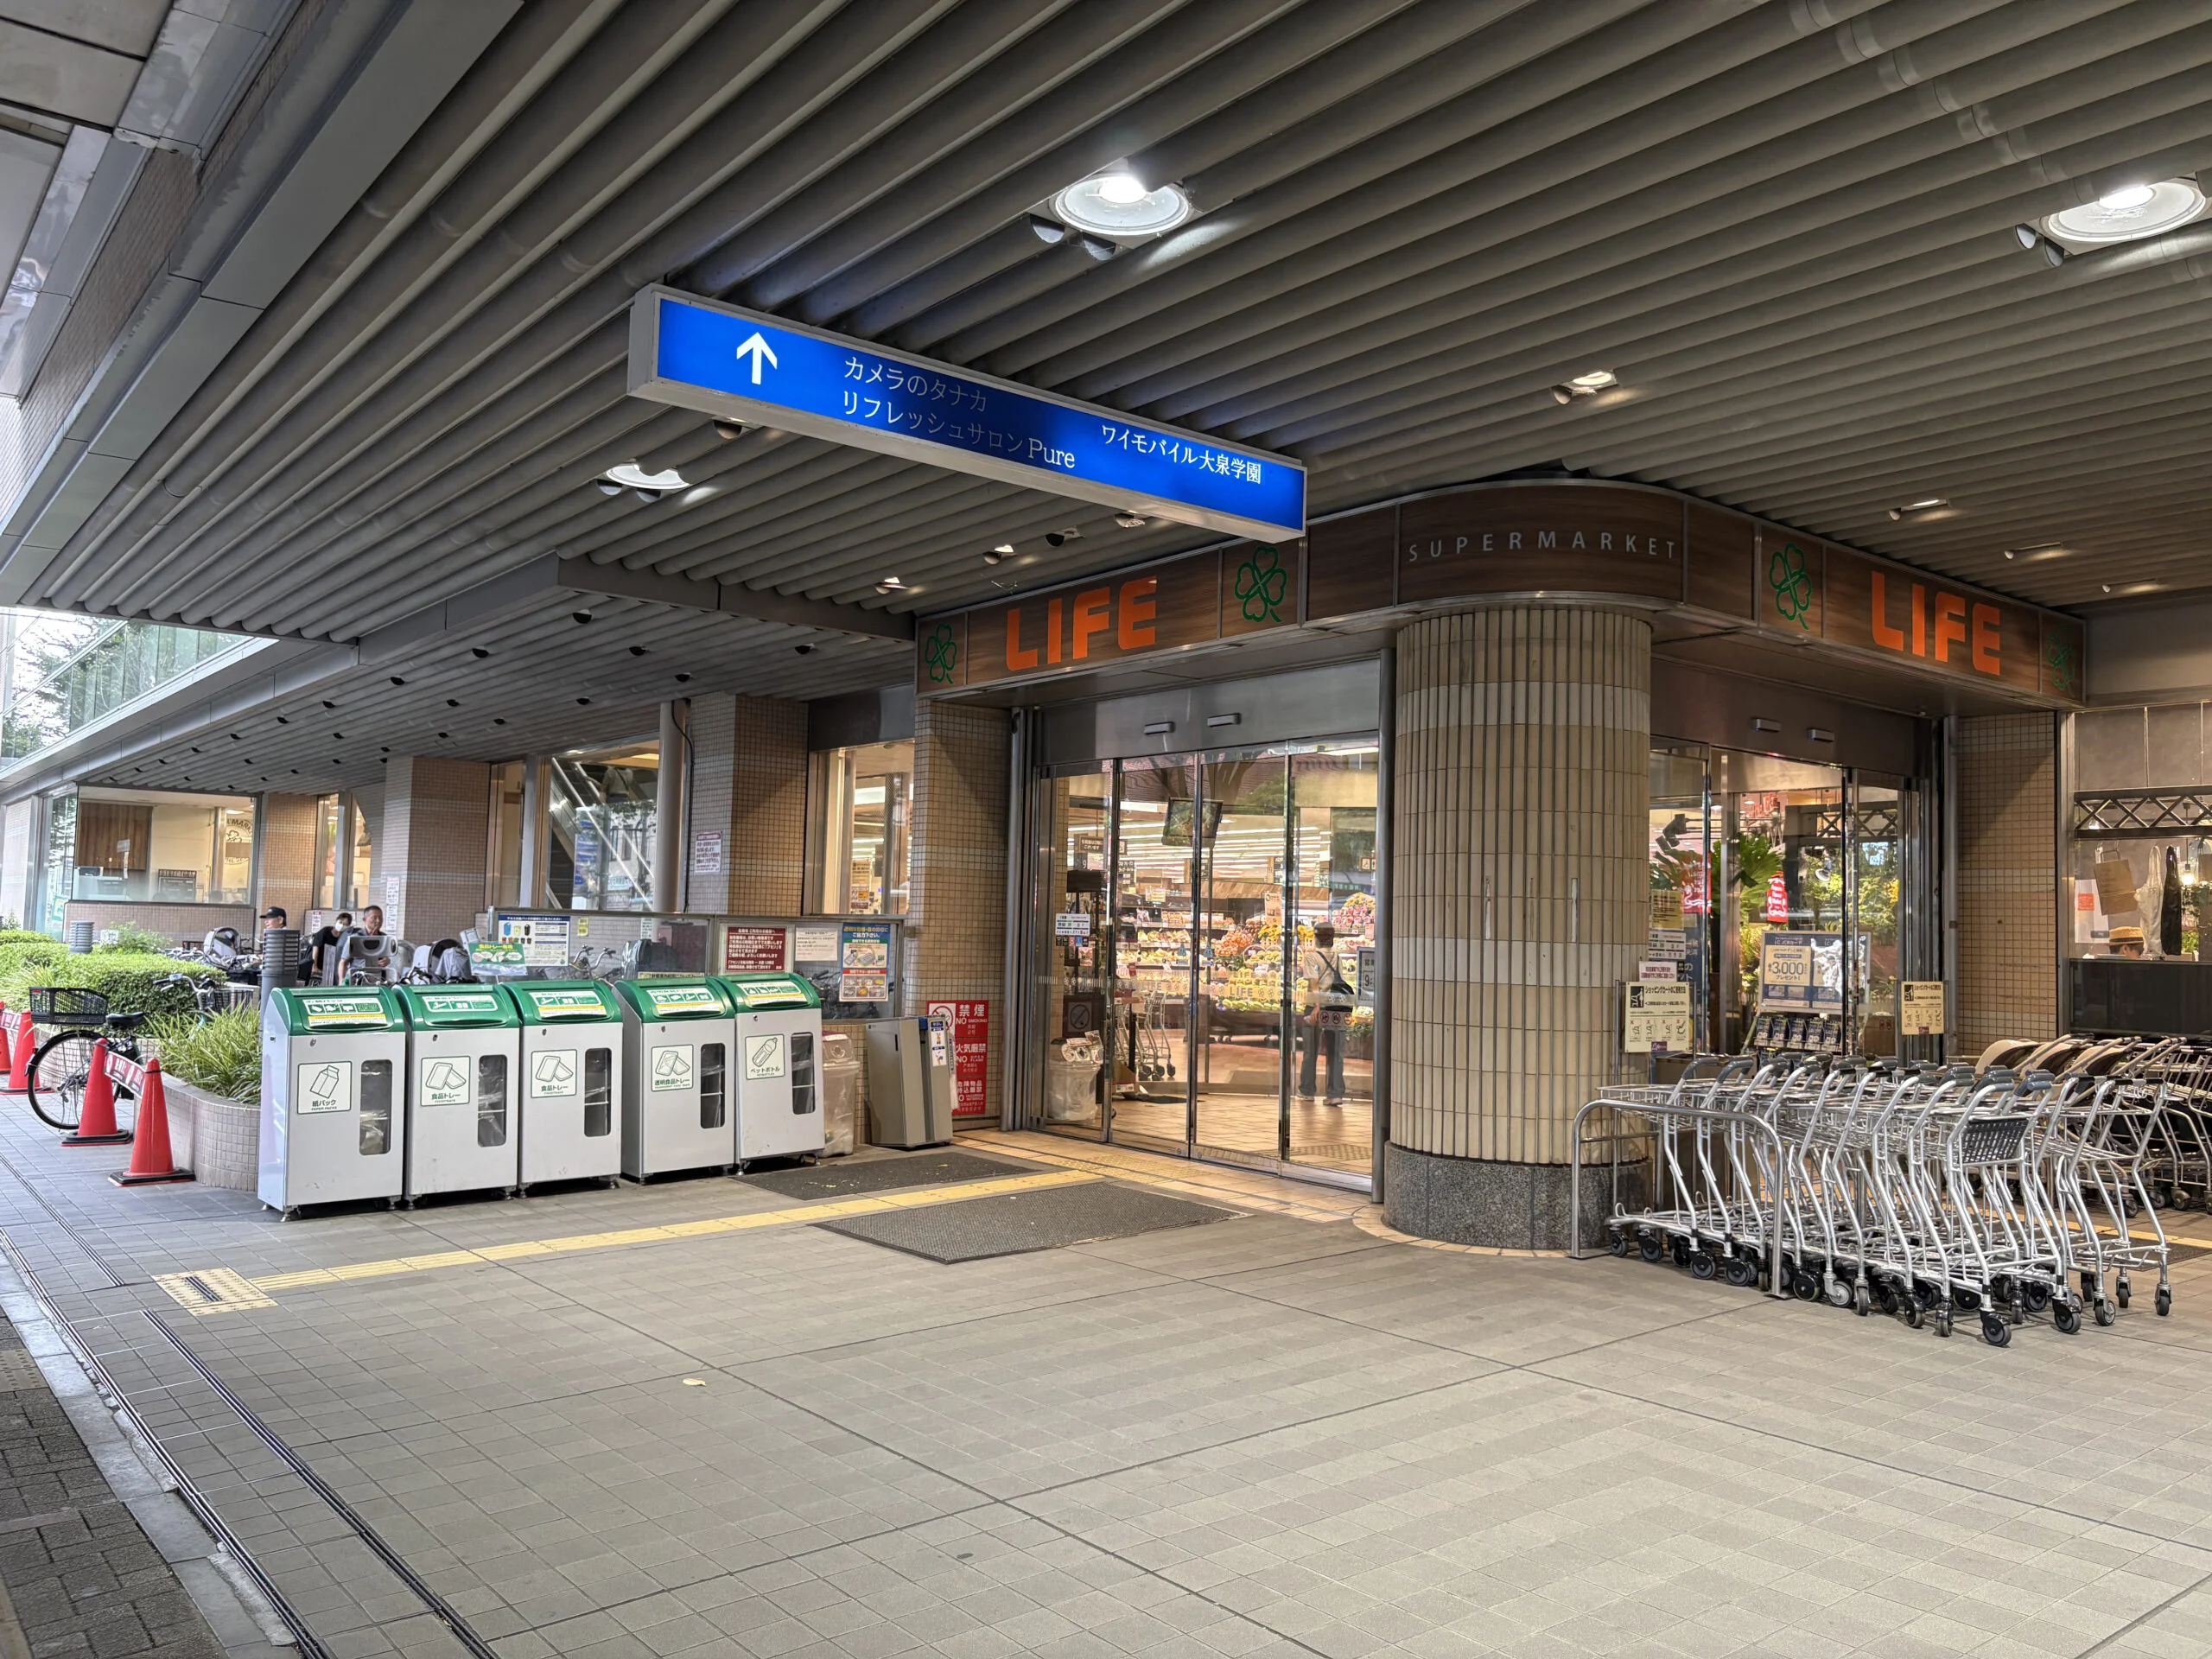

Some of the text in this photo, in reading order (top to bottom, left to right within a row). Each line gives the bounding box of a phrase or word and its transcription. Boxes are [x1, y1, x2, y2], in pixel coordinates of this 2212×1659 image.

[844, 356, 987, 412] カメラのタナカ
[843, 391, 1076, 469] リフレッシュサロン Pure
[1101, 424, 1262, 485] ワイモバイル大泉学園
[1408, 531, 1675, 562] SUPERMARKET
[1006, 575, 1157, 671] LIFE
[1872, 570, 2000, 676] LIFE
[1771, 961, 1804, 975] 3,000
[1229, 986, 1253, 997] LIFE
[959, 1003, 985, 1017] 禁煙
[956, 1043, 987, 1053] 火気厳禁
[312, 1098, 337, 1107] 紙パック
